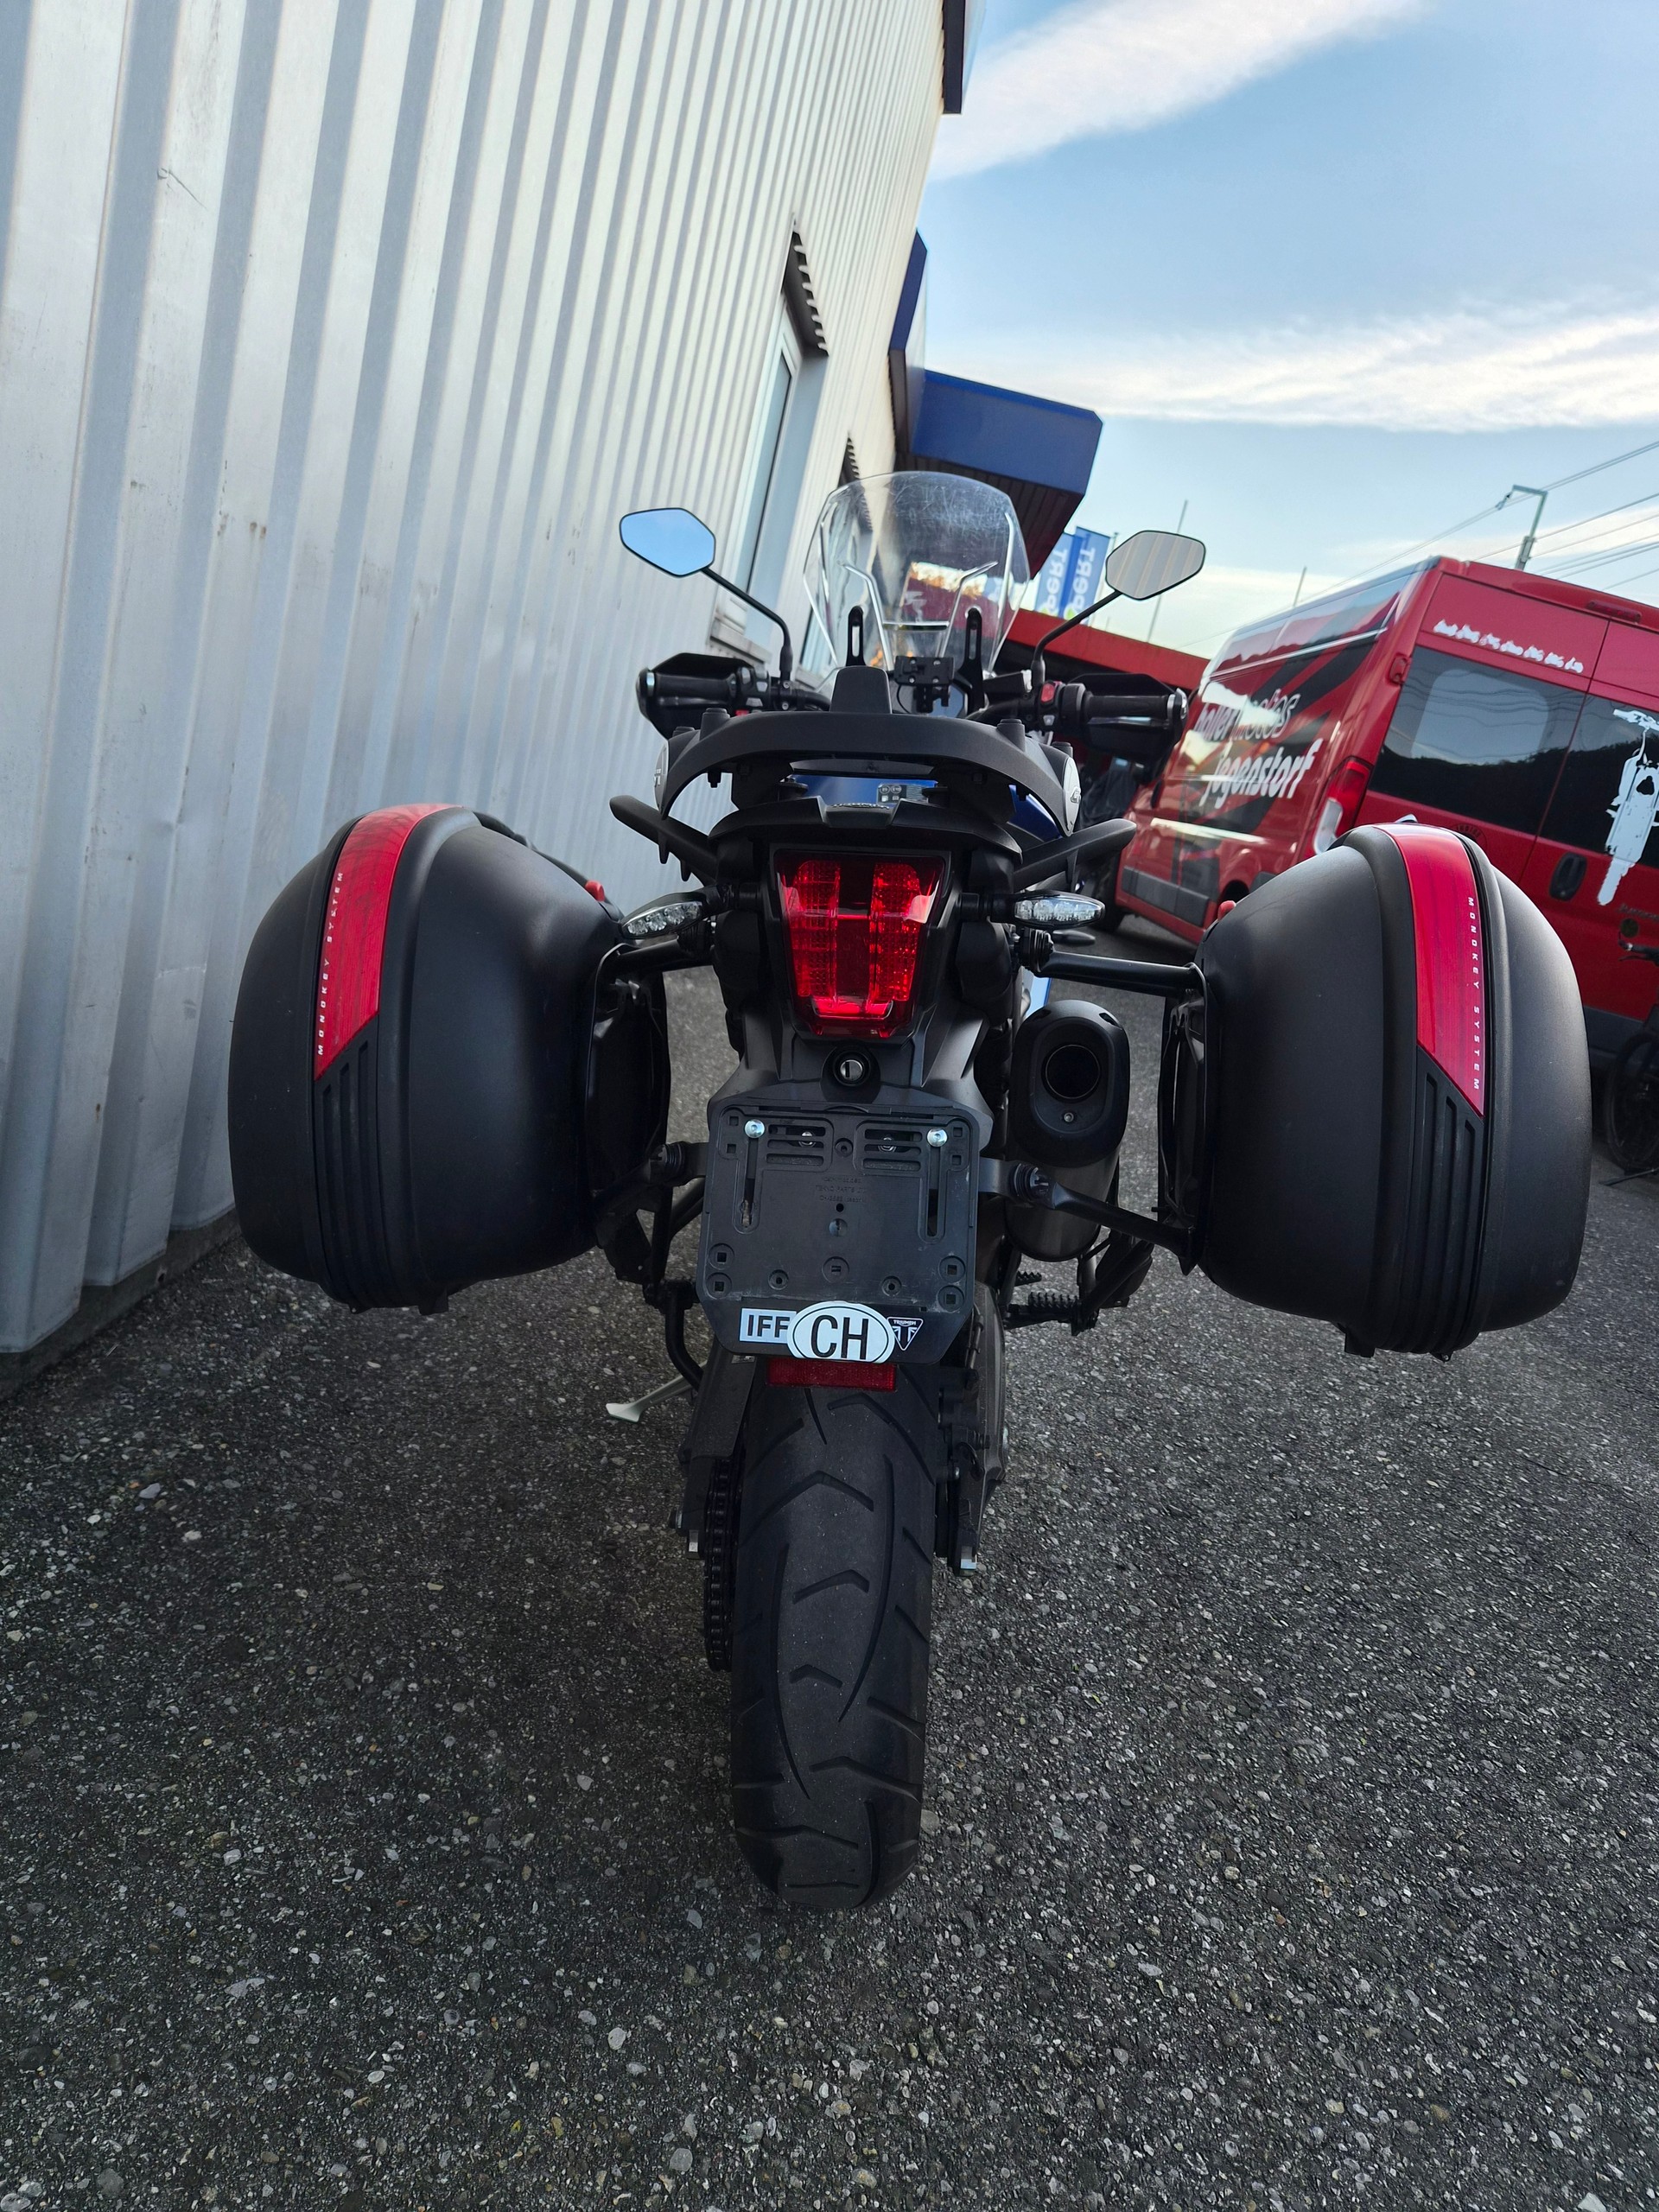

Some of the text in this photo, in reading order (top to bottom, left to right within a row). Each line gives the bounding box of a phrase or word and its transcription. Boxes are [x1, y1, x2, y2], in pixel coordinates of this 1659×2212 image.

[317, 872, 344, 1056] MONOKEY SYSTEM
[1468, 896, 1480, 989] MONOKEY
[810, 1314, 869, 1360] CH
